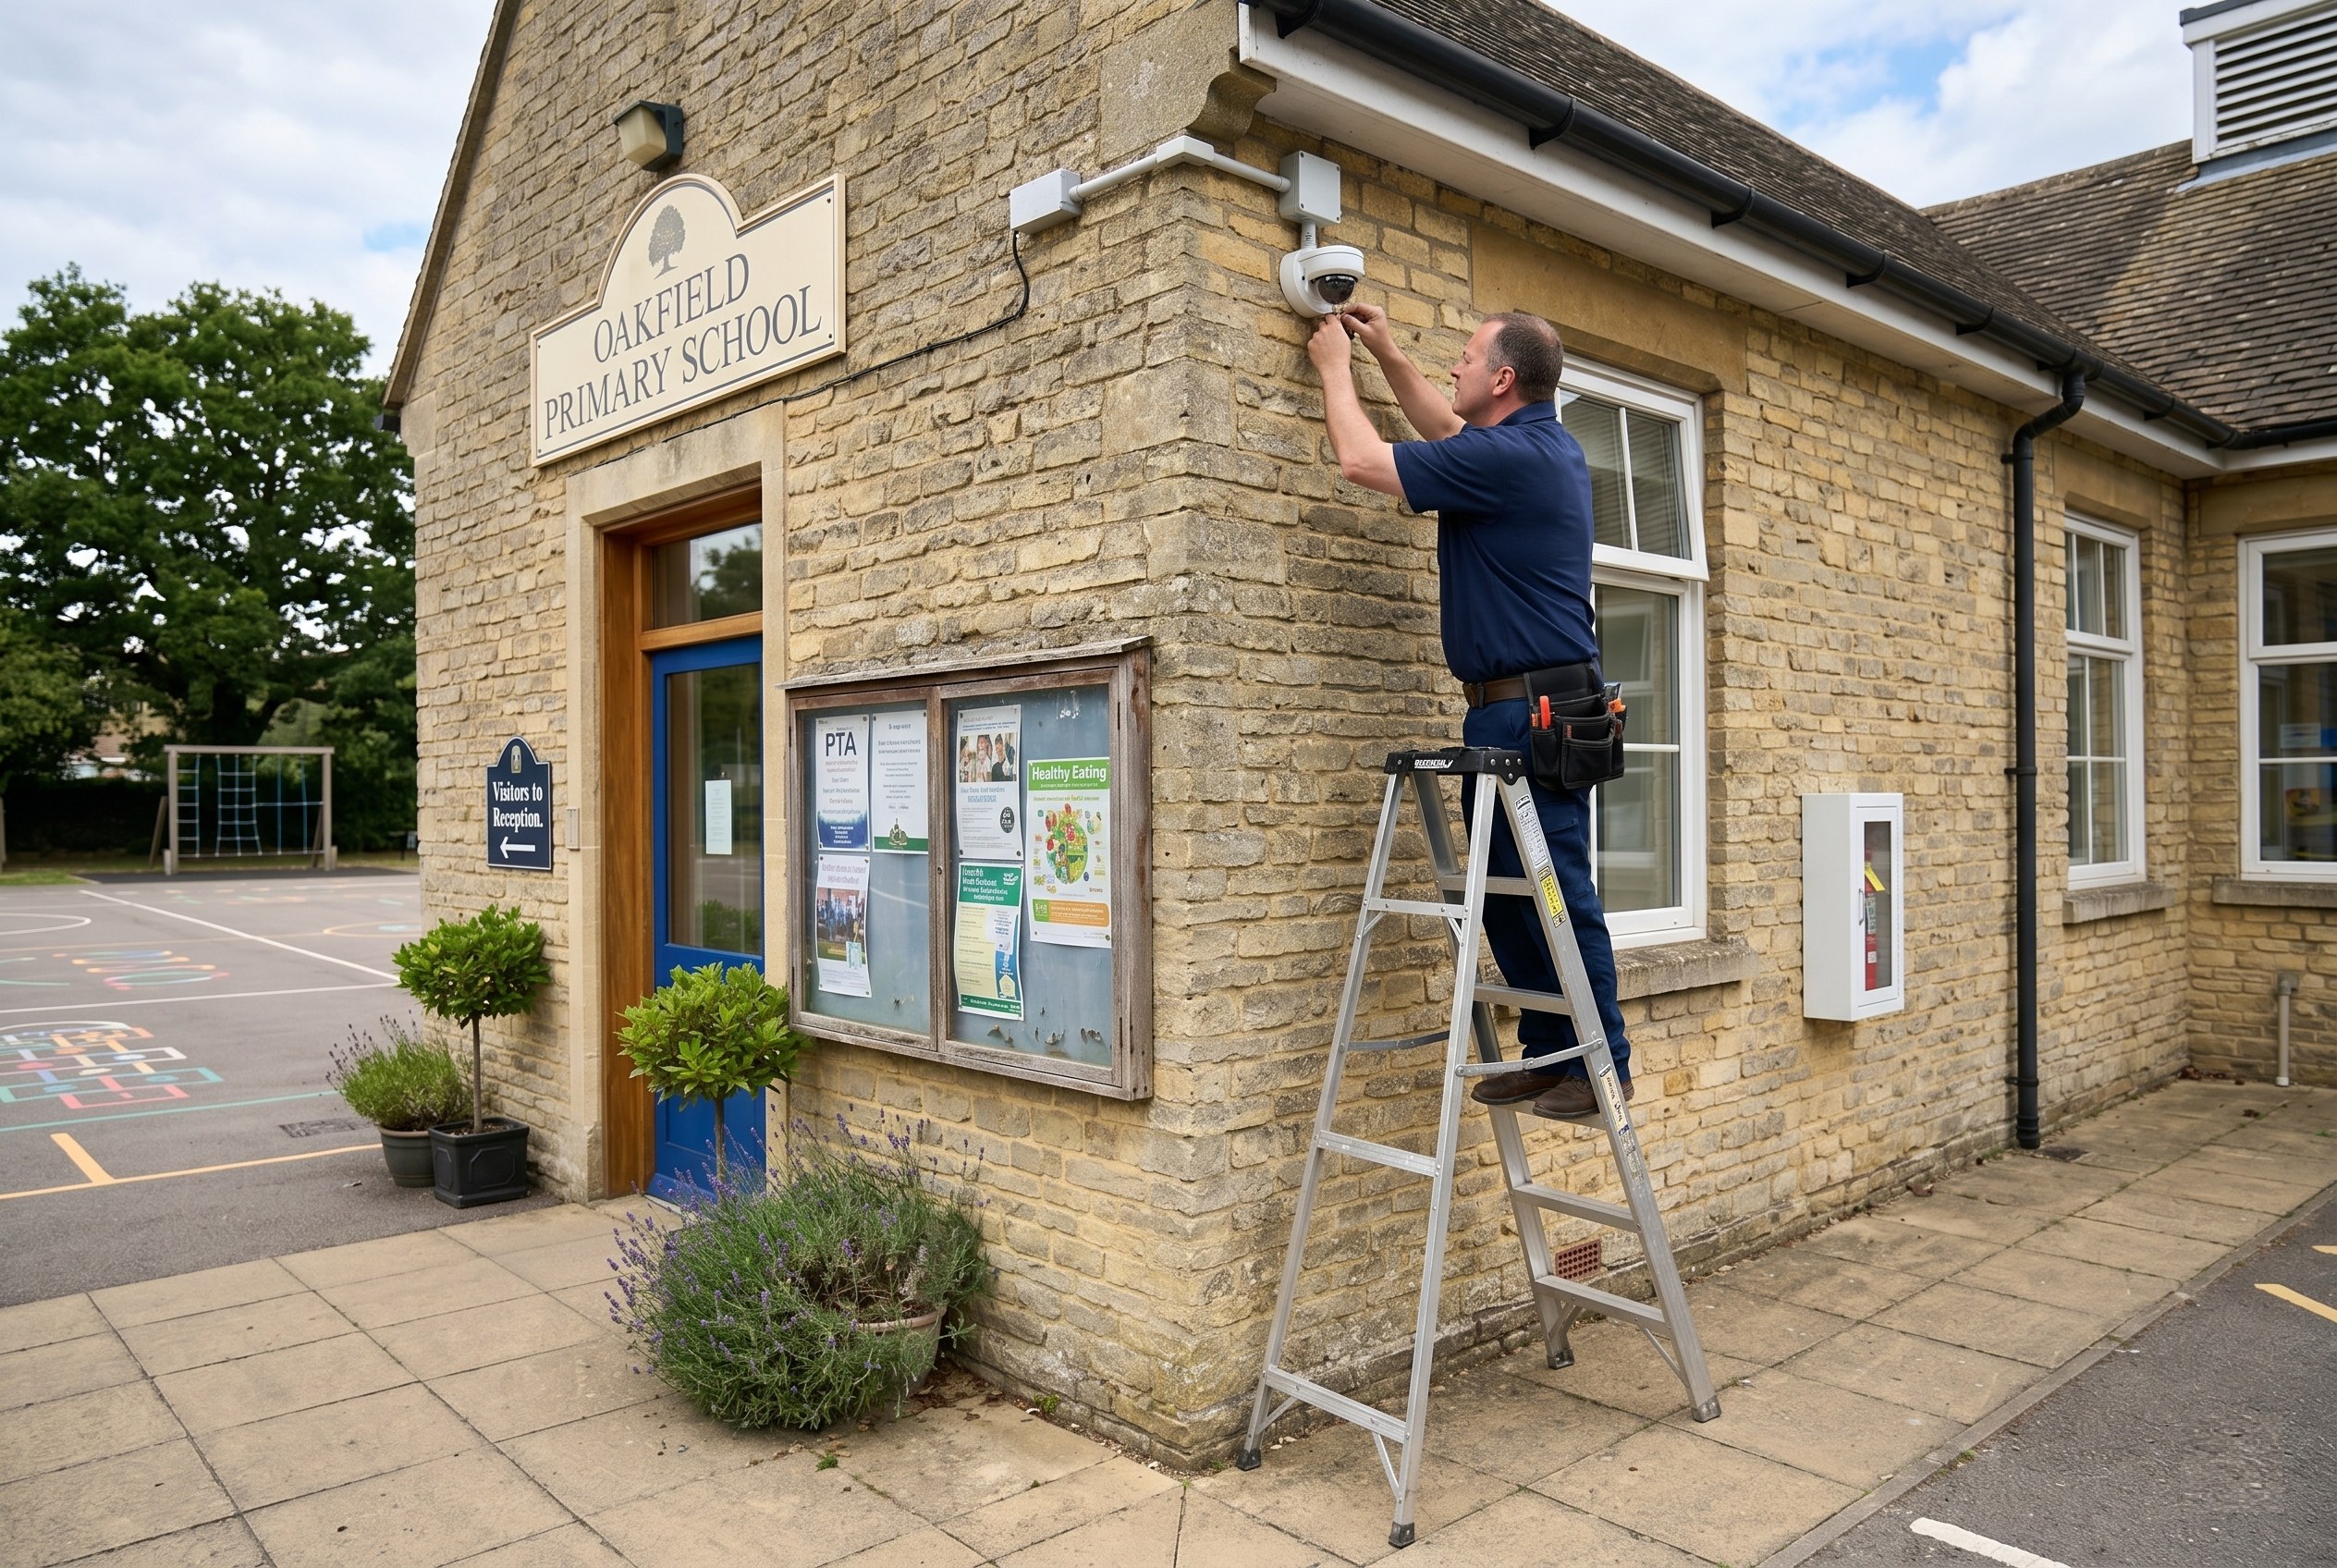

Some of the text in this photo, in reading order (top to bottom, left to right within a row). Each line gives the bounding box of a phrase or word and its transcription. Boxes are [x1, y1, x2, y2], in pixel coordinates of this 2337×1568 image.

[593, 253, 750, 362] OAKFIELD
[544, 285, 822, 439] PRIMARY SCHOOL
[826, 731, 857, 756] PTA
[1032, 764, 1107, 782] Healthy Eating
[493, 781, 544, 802] Visitors to
[493, 807, 544, 833] Reception.
